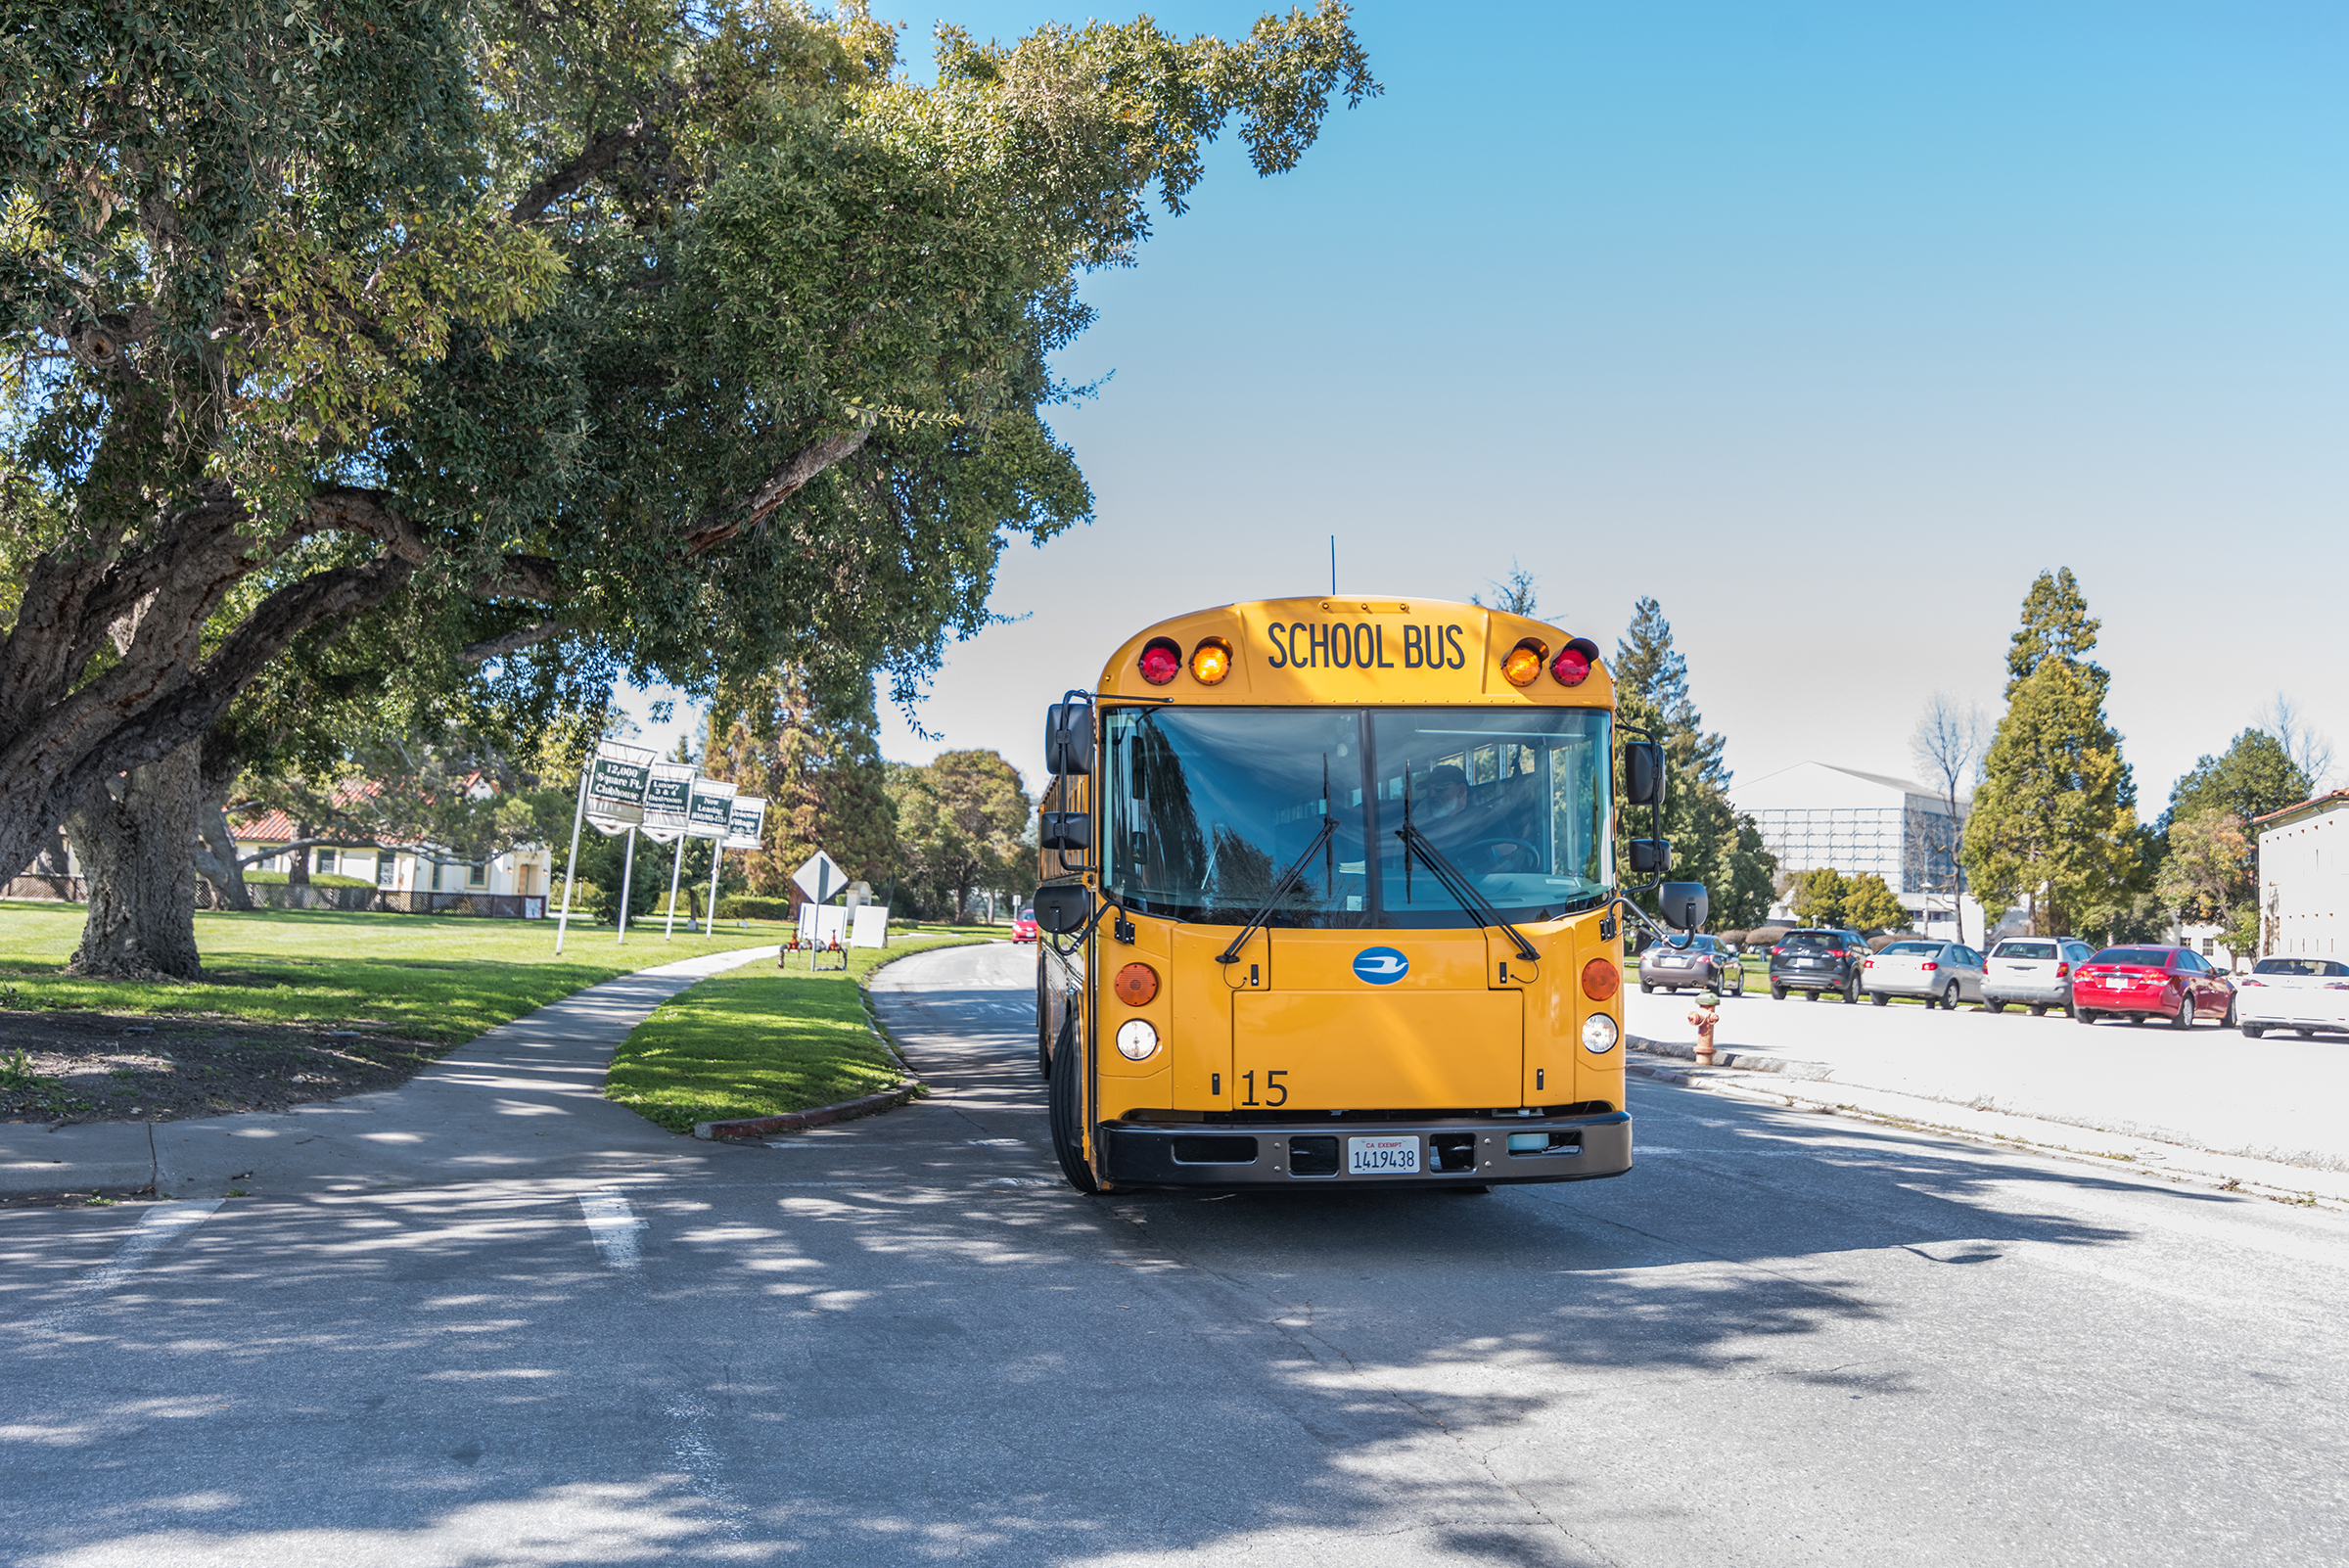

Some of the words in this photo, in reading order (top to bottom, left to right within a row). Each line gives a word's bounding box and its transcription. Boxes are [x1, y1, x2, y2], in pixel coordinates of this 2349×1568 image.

[1267, 622, 1395, 669] SCHOOL
[1403, 623, 1466, 670] BUS
[606, 763, 638, 778] 12,000
[595, 772, 628, 787] Square
[653, 780, 681, 792] Luxury
[595, 783, 640, 801] Clubhouse
[648, 794, 683, 805] Bedroom
[704, 797, 719, 807] Now
[697, 804, 724, 816] Leasing
[1242, 1070, 1288, 1107] 15
[1354, 1150, 1415, 1169] 1419438
